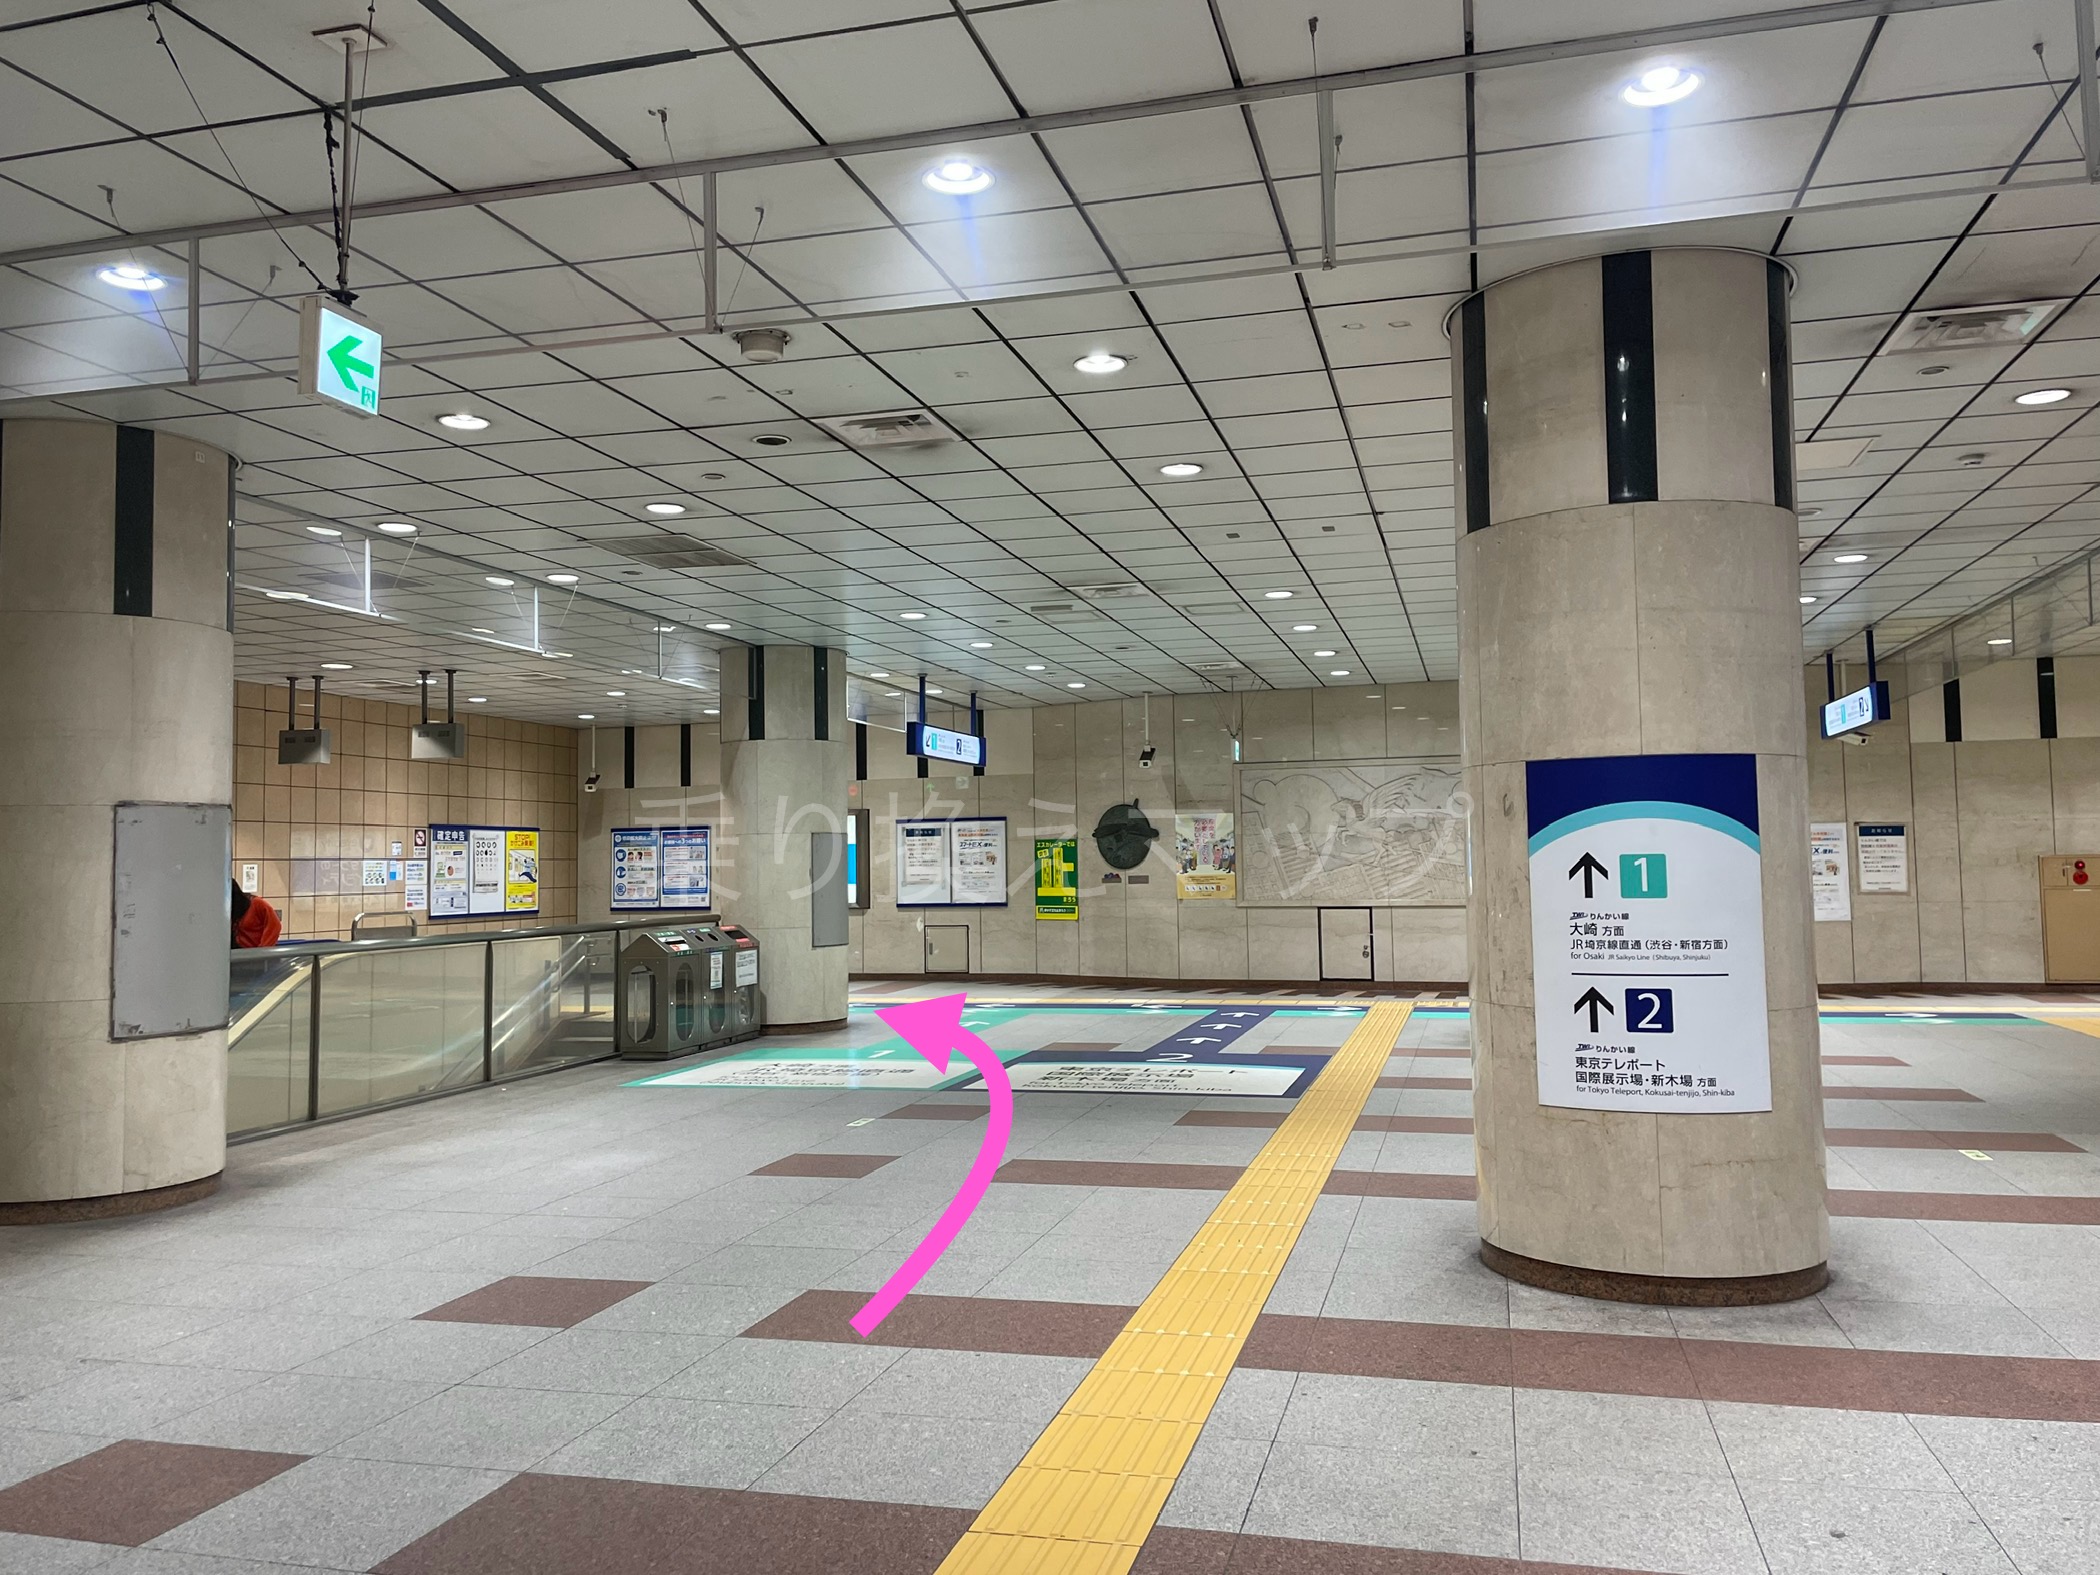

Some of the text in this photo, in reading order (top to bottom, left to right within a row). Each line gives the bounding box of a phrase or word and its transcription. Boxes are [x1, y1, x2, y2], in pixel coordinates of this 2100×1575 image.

[436, 830, 465, 841] 確定申告
[1634, 857, 1649, 892] 1
[1590, 912, 1630, 920] りんかい線
[1569, 921, 1624, 937] 大崎 方面
[1570, 951, 1581, 960] for
[1583, 952, 1605, 960] Osaki
[1637, 992, 1663, 1029] 2
[1595, 1045, 1636, 1054] りんかい線
[1146, 1053, 1193, 1062] 2
[1059, 1066, 1249, 1074] 東京テレポート
[1575, 1056, 1666, 1072] 東京テレポート
[1575, 1071, 1717, 1088] 国際展示場・新木場 方面
[1588, 1085, 1610, 1095] Tokyo
[1610, 1087, 1643, 1096] Teleport,
[1645, 1089, 1701, 1098] Kokusai-tenjijo,
[1702, 1089, 1735, 1097] Shin-kiba
